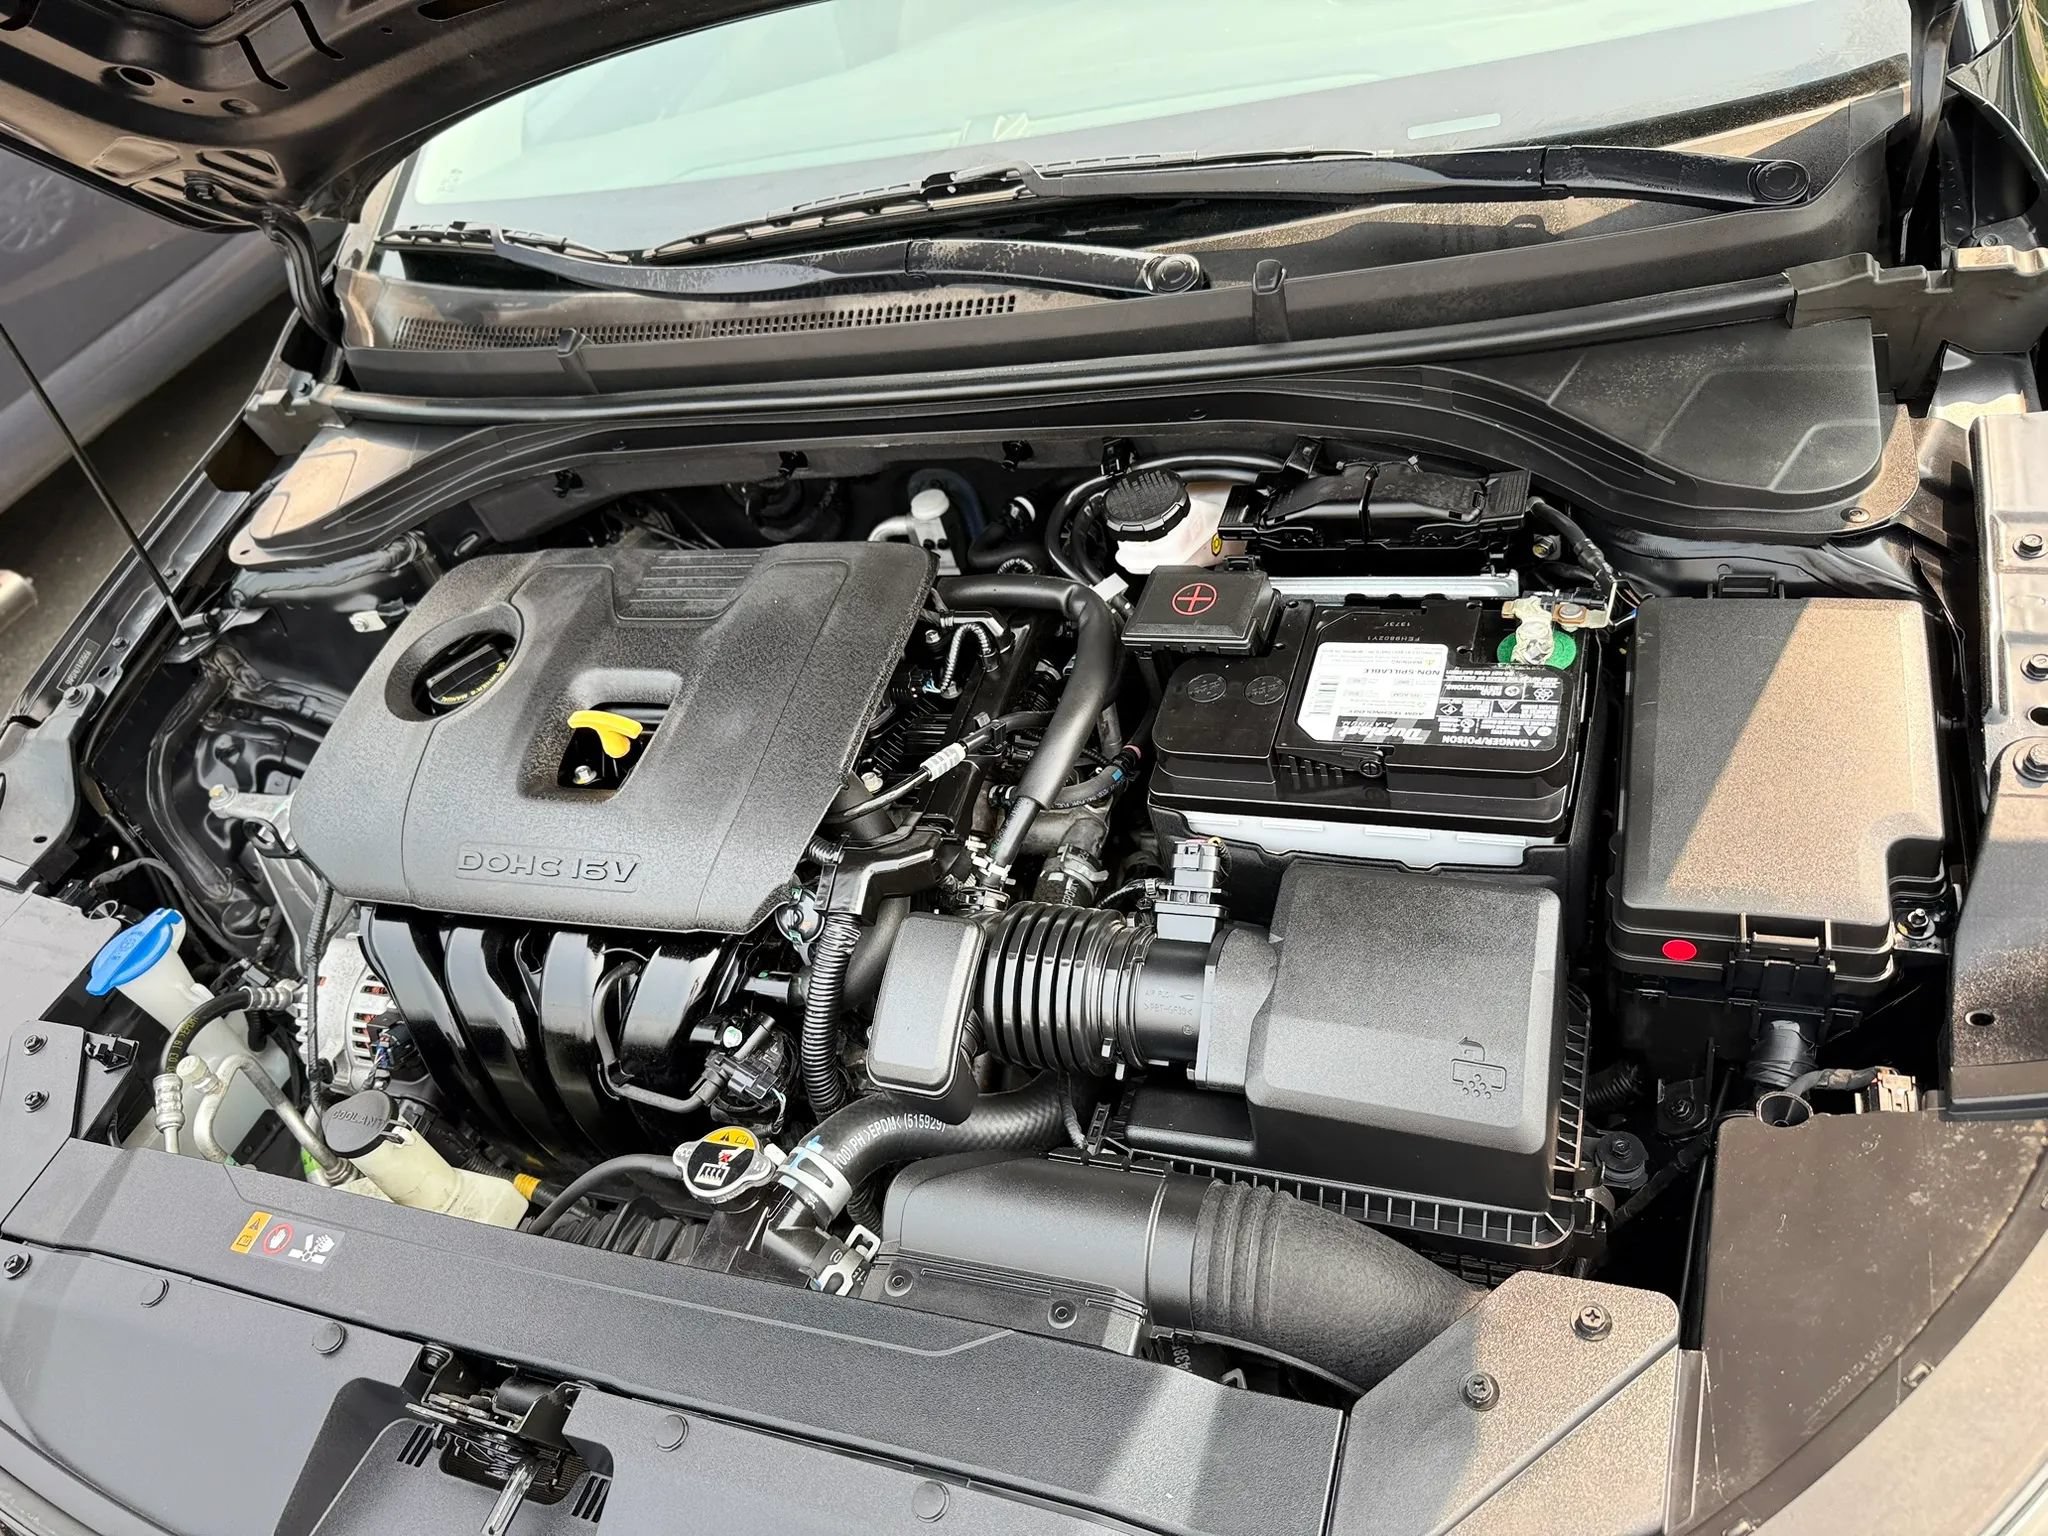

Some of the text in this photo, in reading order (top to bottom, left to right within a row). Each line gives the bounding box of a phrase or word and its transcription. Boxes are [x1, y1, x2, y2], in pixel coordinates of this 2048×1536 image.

[1338, 724, 1424, 741] Duralast
[1441, 735, 1529, 748] DANGER/POISON
[457, 851, 640, 883] DOHC 16V
[331, 1109, 386, 1130] COOLANT
[848, 1132, 867, 1152] PH
